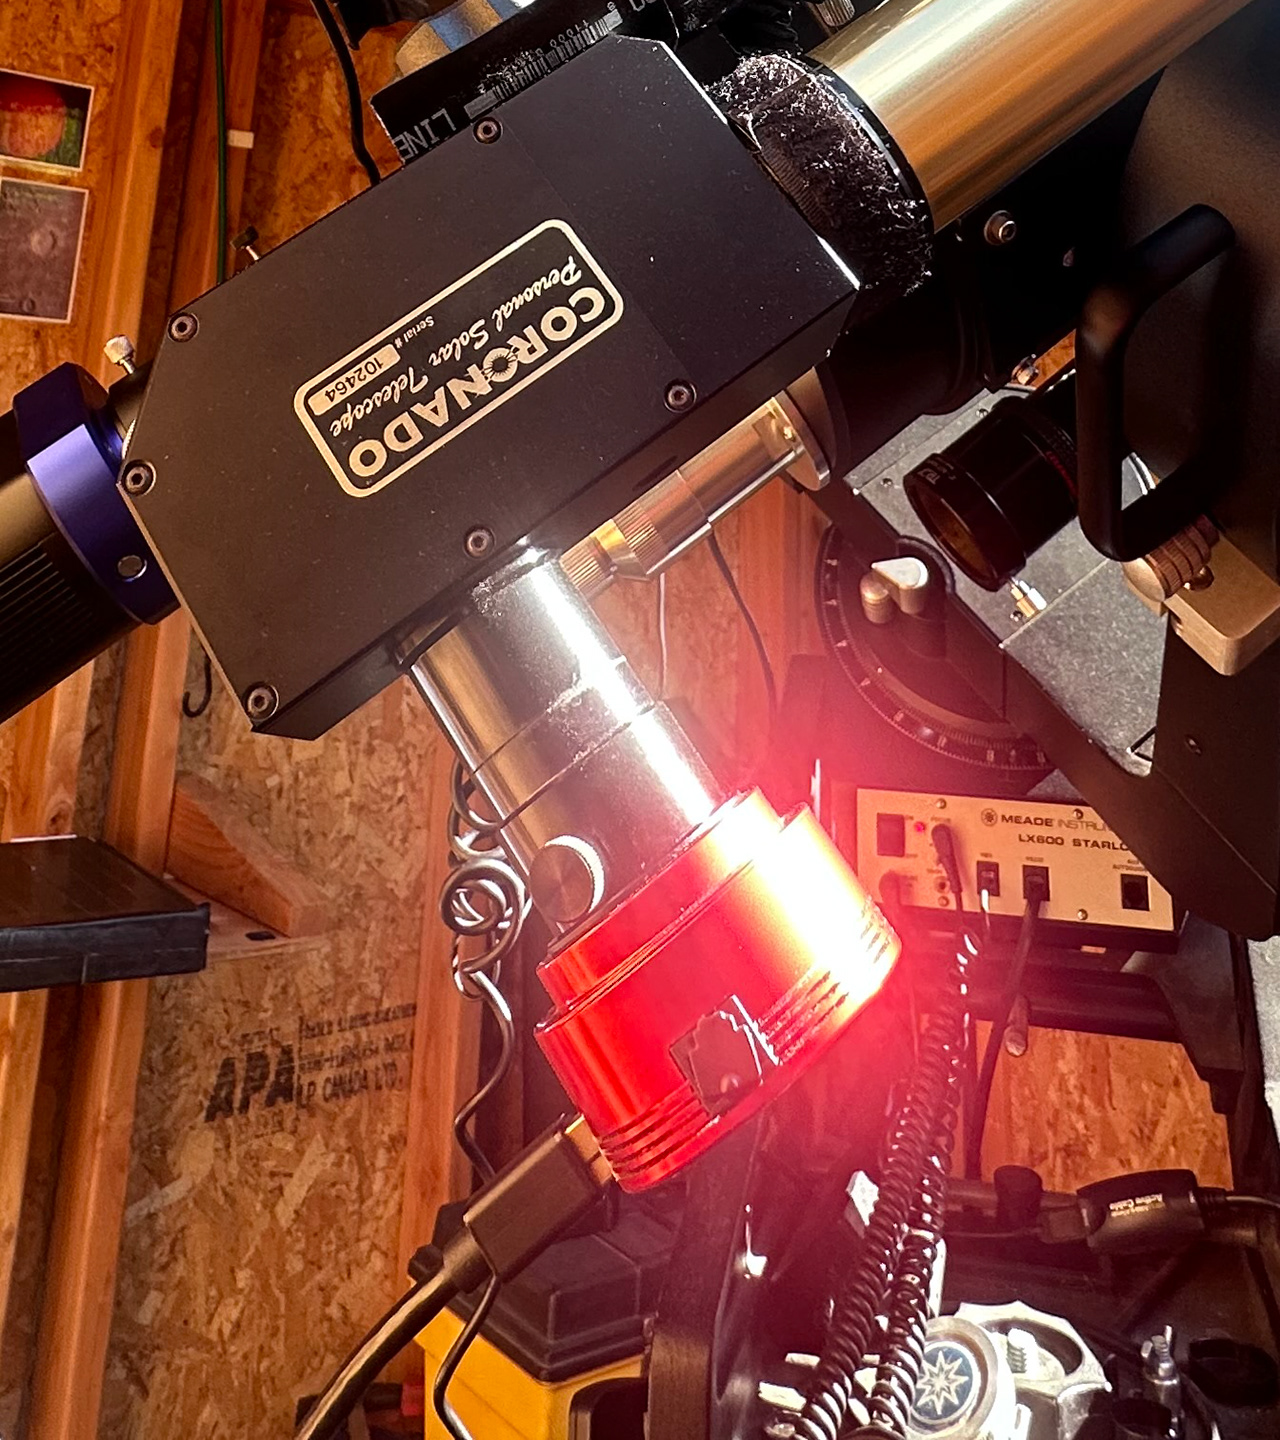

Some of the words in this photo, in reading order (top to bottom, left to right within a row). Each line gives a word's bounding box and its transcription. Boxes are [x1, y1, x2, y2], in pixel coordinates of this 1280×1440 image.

[392, 108, 457, 160] LINE
[491, 256, 582, 330] Personal
[404, 315, 435, 344] Serial
[428, 318, 490, 366] Solar
[324, 355, 384, 403] 102464
[329, 366, 429, 437] Telescope
[349, 287, 606, 477] CORONADO
[1001, 814, 1054, 827] MEADE
[1018, 833, 1065, 846] LX600
[204, 1043, 294, 1122] APA
